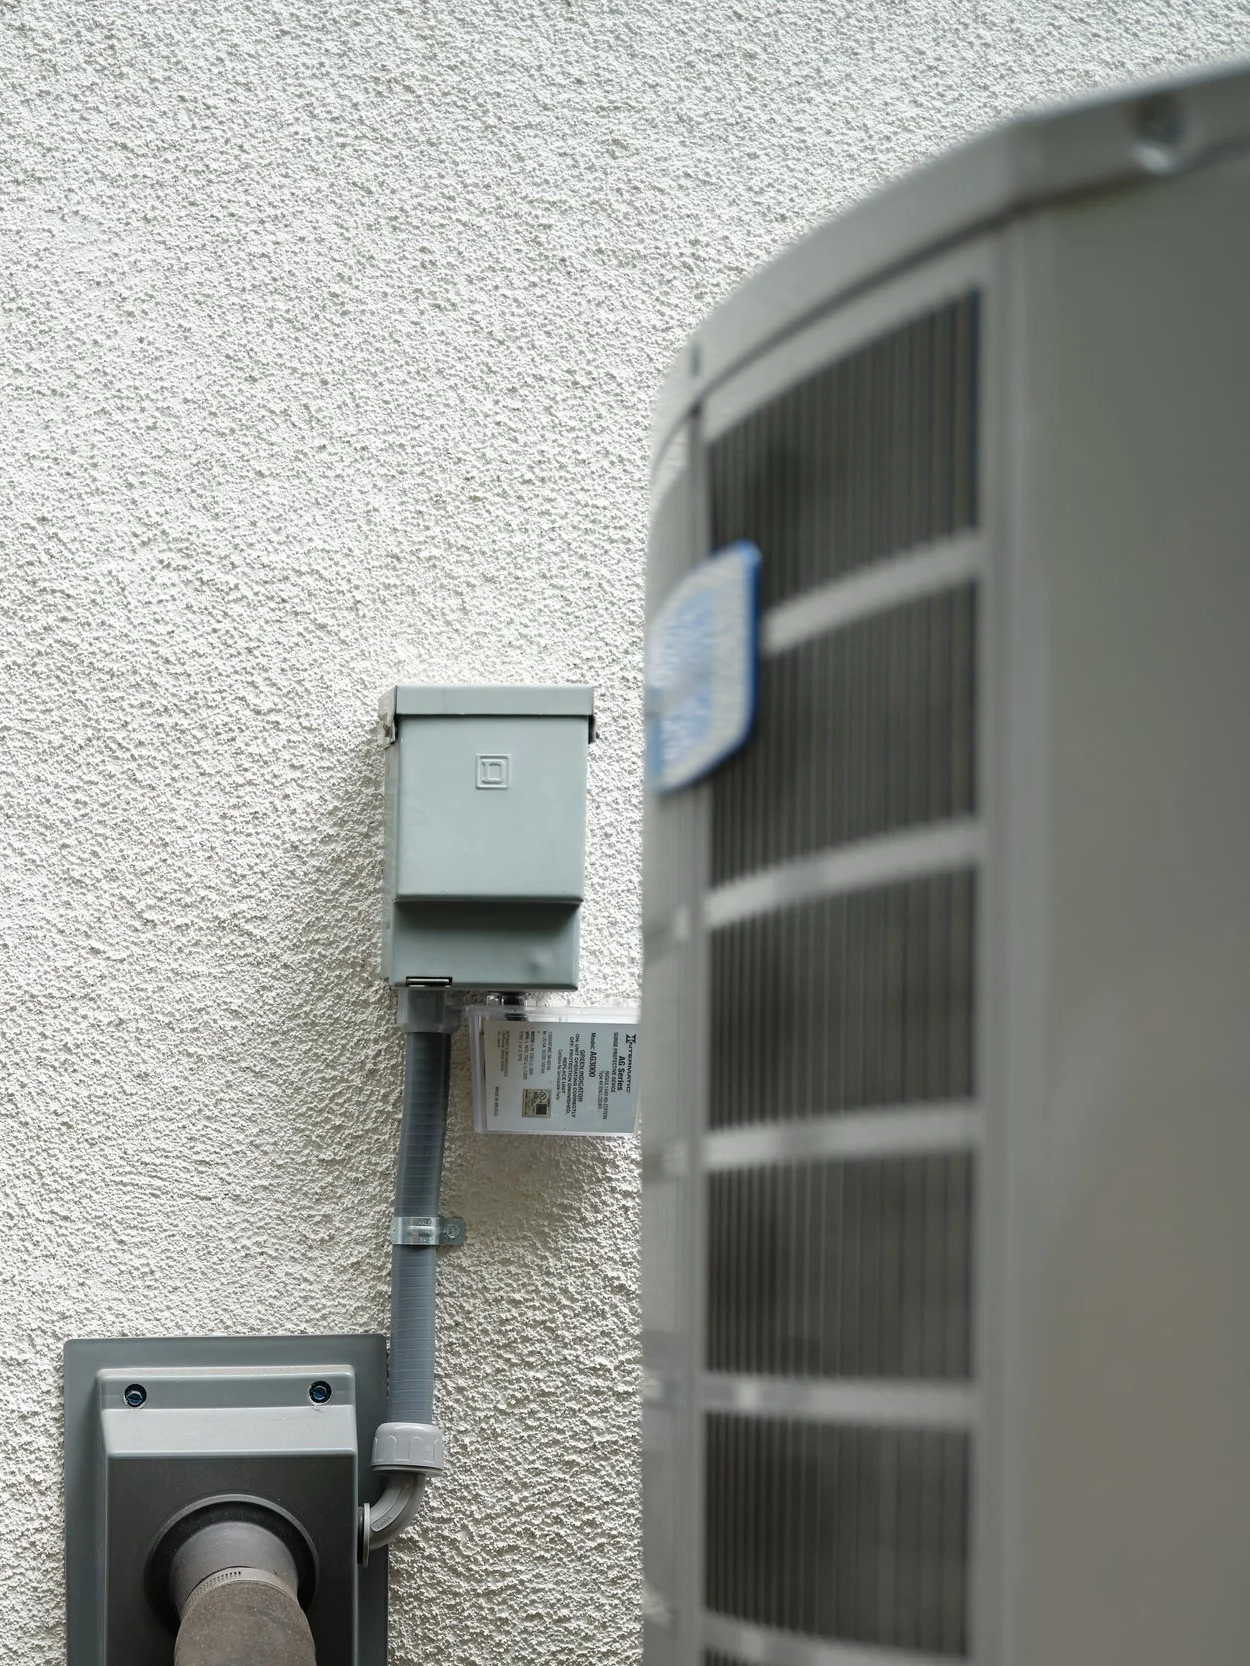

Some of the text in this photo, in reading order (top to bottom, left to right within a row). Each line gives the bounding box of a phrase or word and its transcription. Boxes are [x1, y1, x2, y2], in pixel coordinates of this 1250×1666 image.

[617, 1056, 625, 1091] AG Series
[626, 1034, 636, 1093] INTERMATIC
